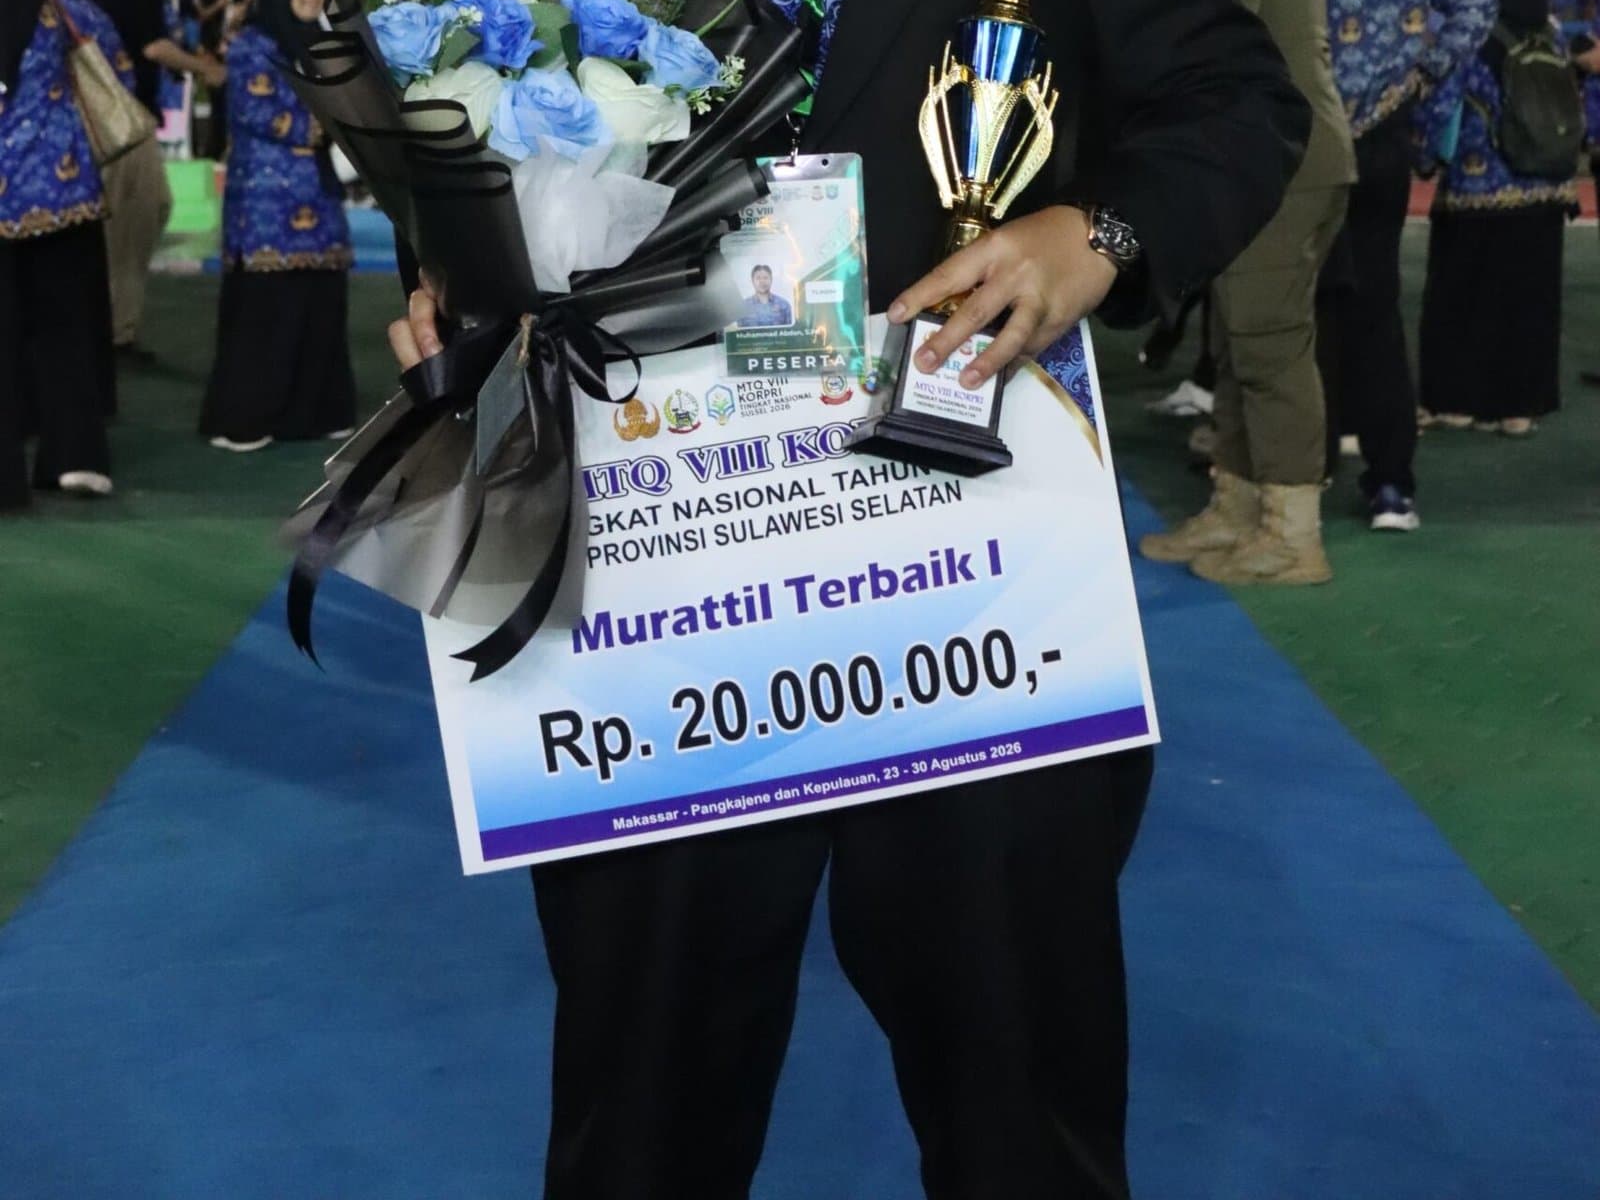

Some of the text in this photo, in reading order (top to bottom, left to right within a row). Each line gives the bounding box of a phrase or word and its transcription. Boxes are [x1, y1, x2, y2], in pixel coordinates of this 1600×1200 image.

[747, 353, 846, 371] PESERTA
[737, 380, 764, 393] MTQ
[738, 387, 782, 403] KORPRI
[740, 392, 812, 411] TINGKAT NASIONAL
[914, 380, 985, 405] MTQ VIII KORPRI
[741, 404, 791, 418] SULSEL 2026
[677, 434, 774, 484] VIII
[778, 417, 867, 468] KO
[673, 478, 826, 522] NASIONAL
[587, 479, 963, 569] PROVINSI SULAWESI SELATAN
[572, 538, 1004, 655] Murattil Terbaik I
[538, 628, 1063, 781] Rp. 20.000.000,-
[612, 809, 679, 831] Makassar
[690, 791, 771, 817] Pangkajene
[774, 786, 800, 801] dan
[803, 772, 881, 796] Kepulauan,
[883, 766, 900, 781] 23
[911, 761, 928, 775] 30
[930, 750, 987, 772] Agustus
[989, 741, 1022, 760] 2026
